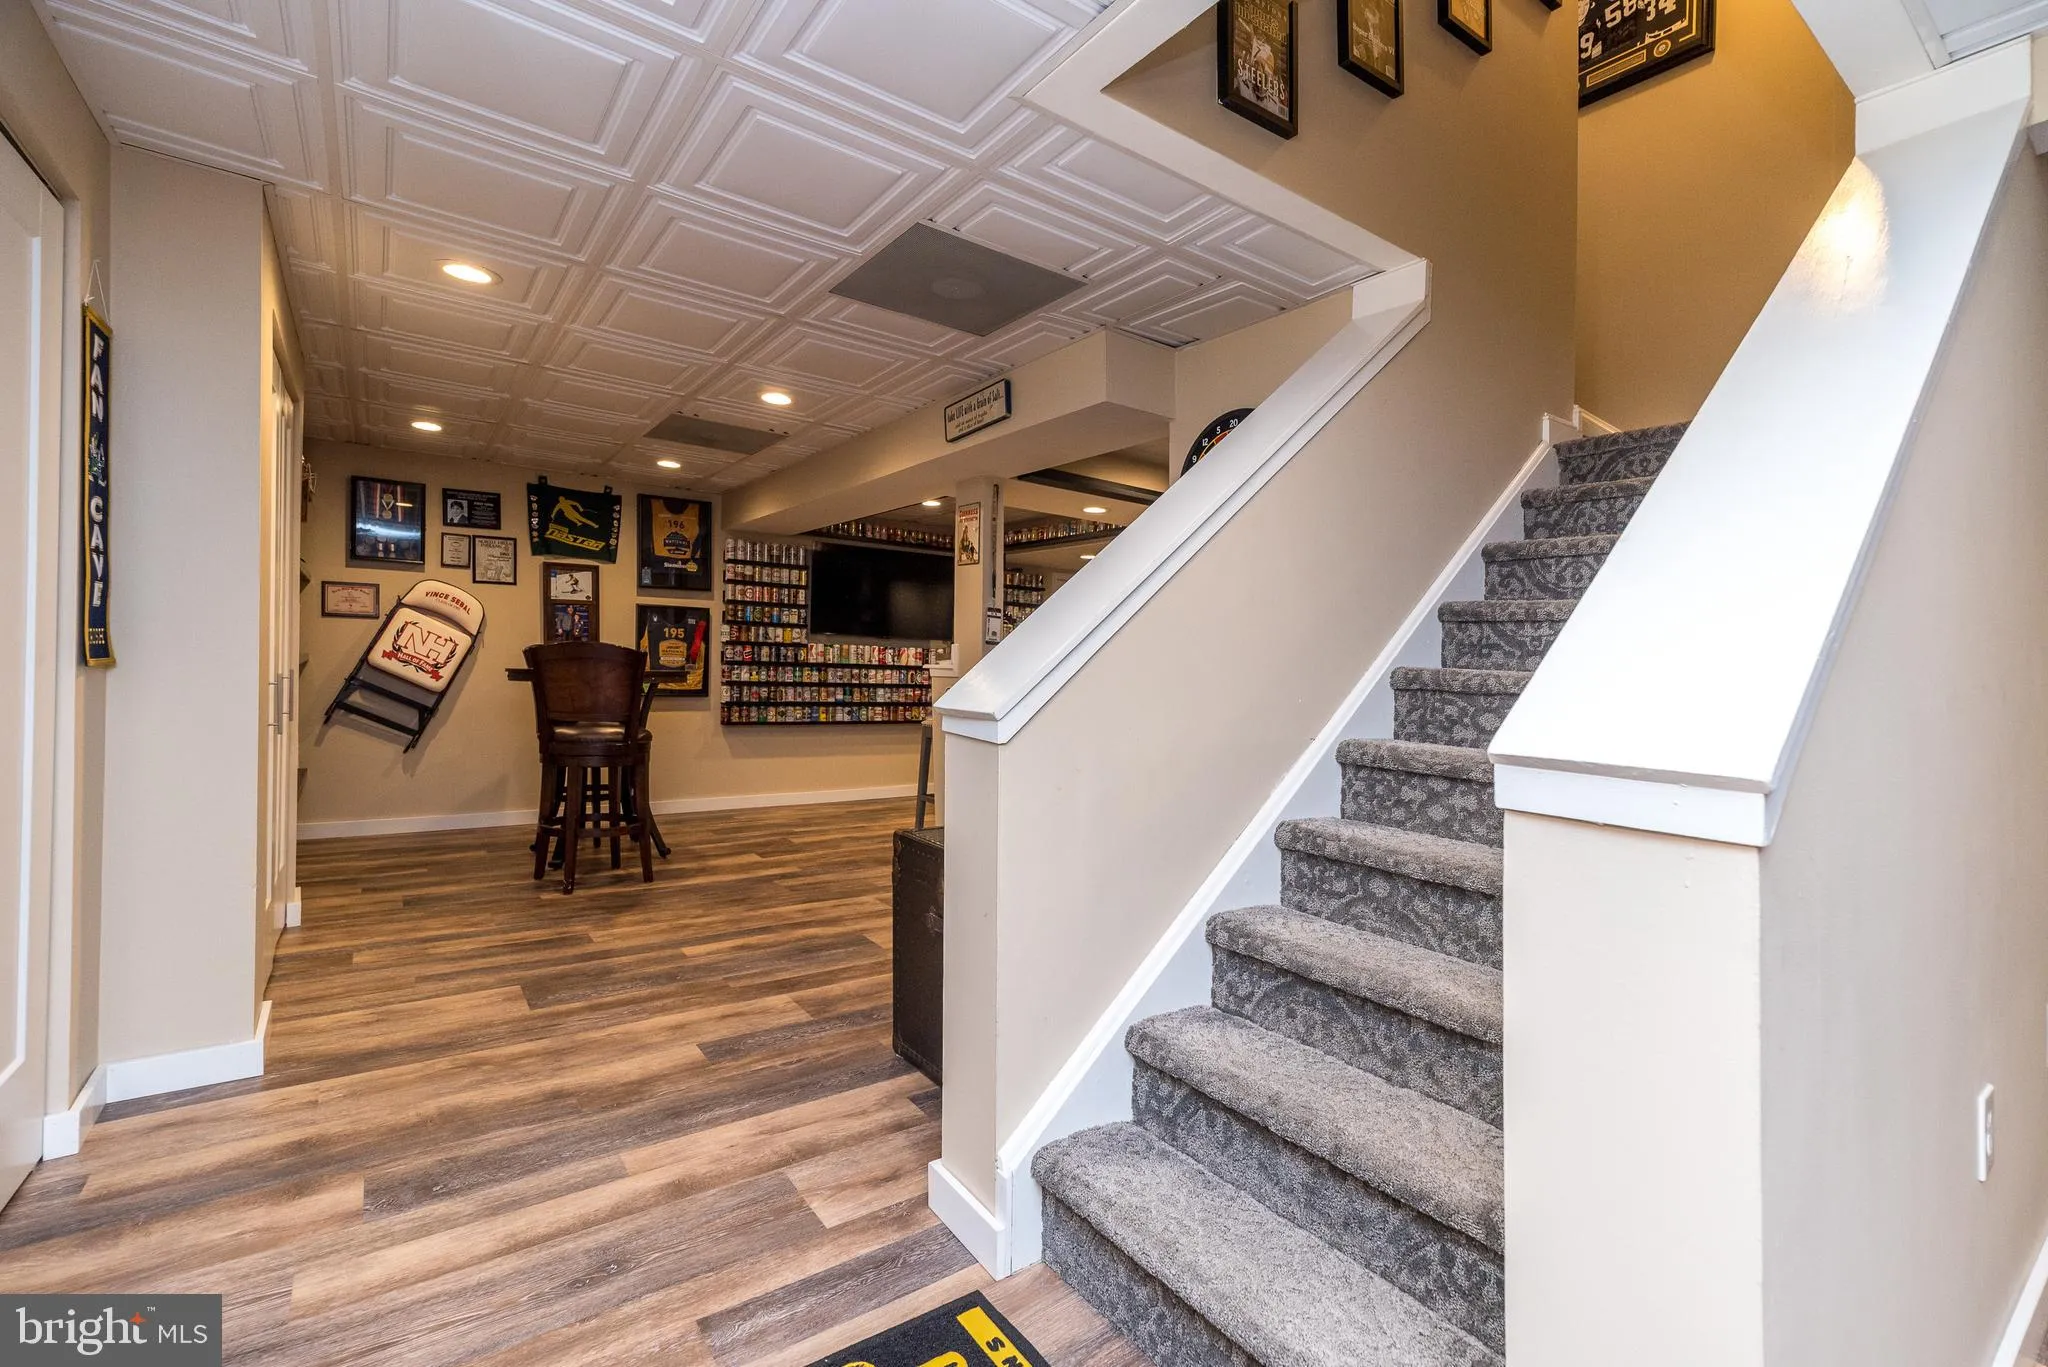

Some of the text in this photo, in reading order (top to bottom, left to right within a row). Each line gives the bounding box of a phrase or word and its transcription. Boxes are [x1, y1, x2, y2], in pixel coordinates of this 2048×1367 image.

[1237, 58, 1285, 100] STEELERS
[1229, 418, 1239, 428] 20
[1216, 426, 1221, 434] 5
[1202, 438, 1209, 446] 12
[1192, 455, 1197, 463] 9
[90, 333, 105, 608] FAN CAVE
[667, 520, 685, 530] 196
[425, 591, 471, 615] VINCE SEBAL
[663, 627, 685, 638] 195
[396, 621, 459, 664] NH
[397, 652, 412, 661] HALL
